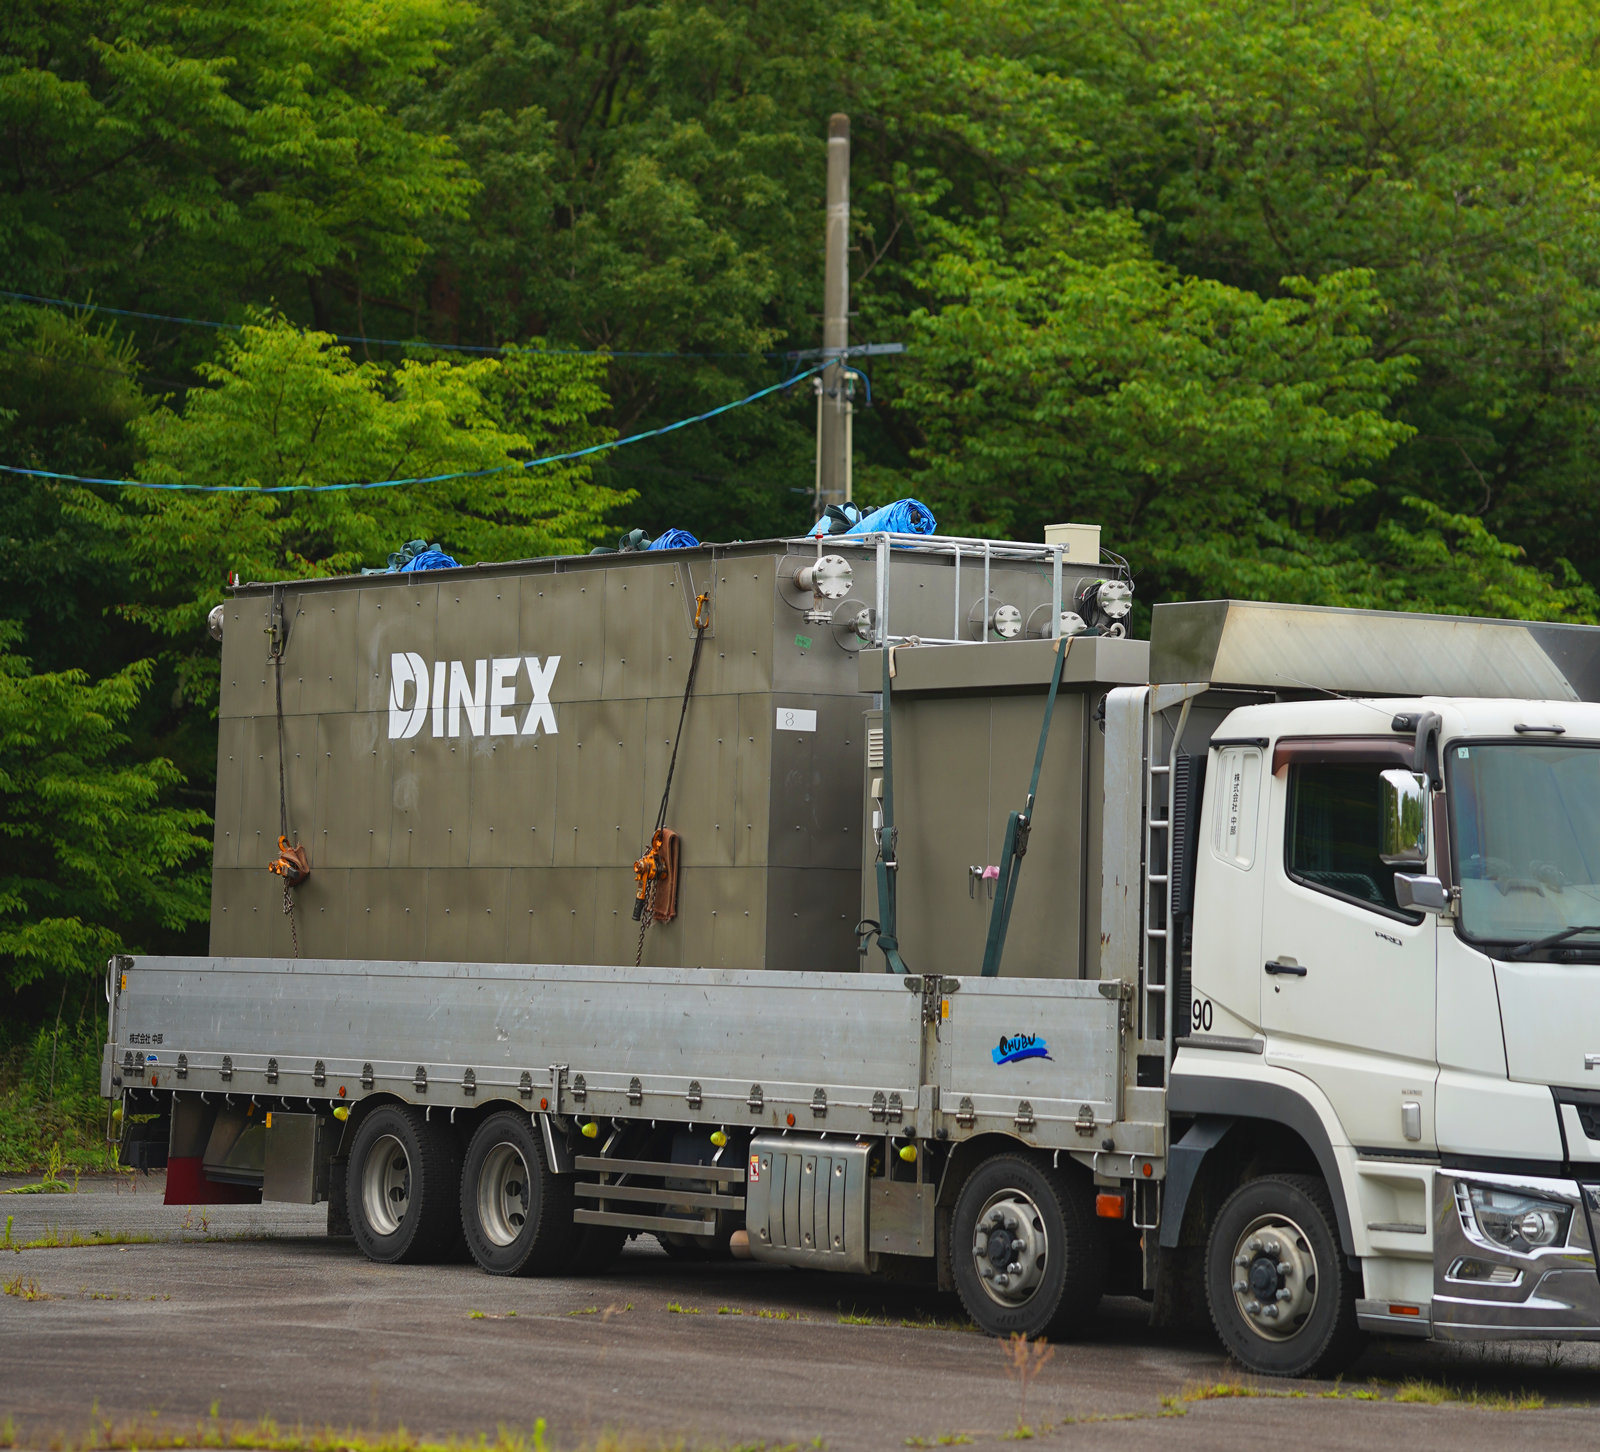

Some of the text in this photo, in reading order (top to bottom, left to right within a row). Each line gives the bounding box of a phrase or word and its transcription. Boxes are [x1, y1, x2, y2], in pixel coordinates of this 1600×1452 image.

[388, 652, 561, 739] DINEX
[785, 711, 795, 727] 8
[1232, 773, 1240, 813] 株式会社
[1192, 999, 1213, 1031] 90
[129, 1033, 164, 1045] 株式会社 中部
